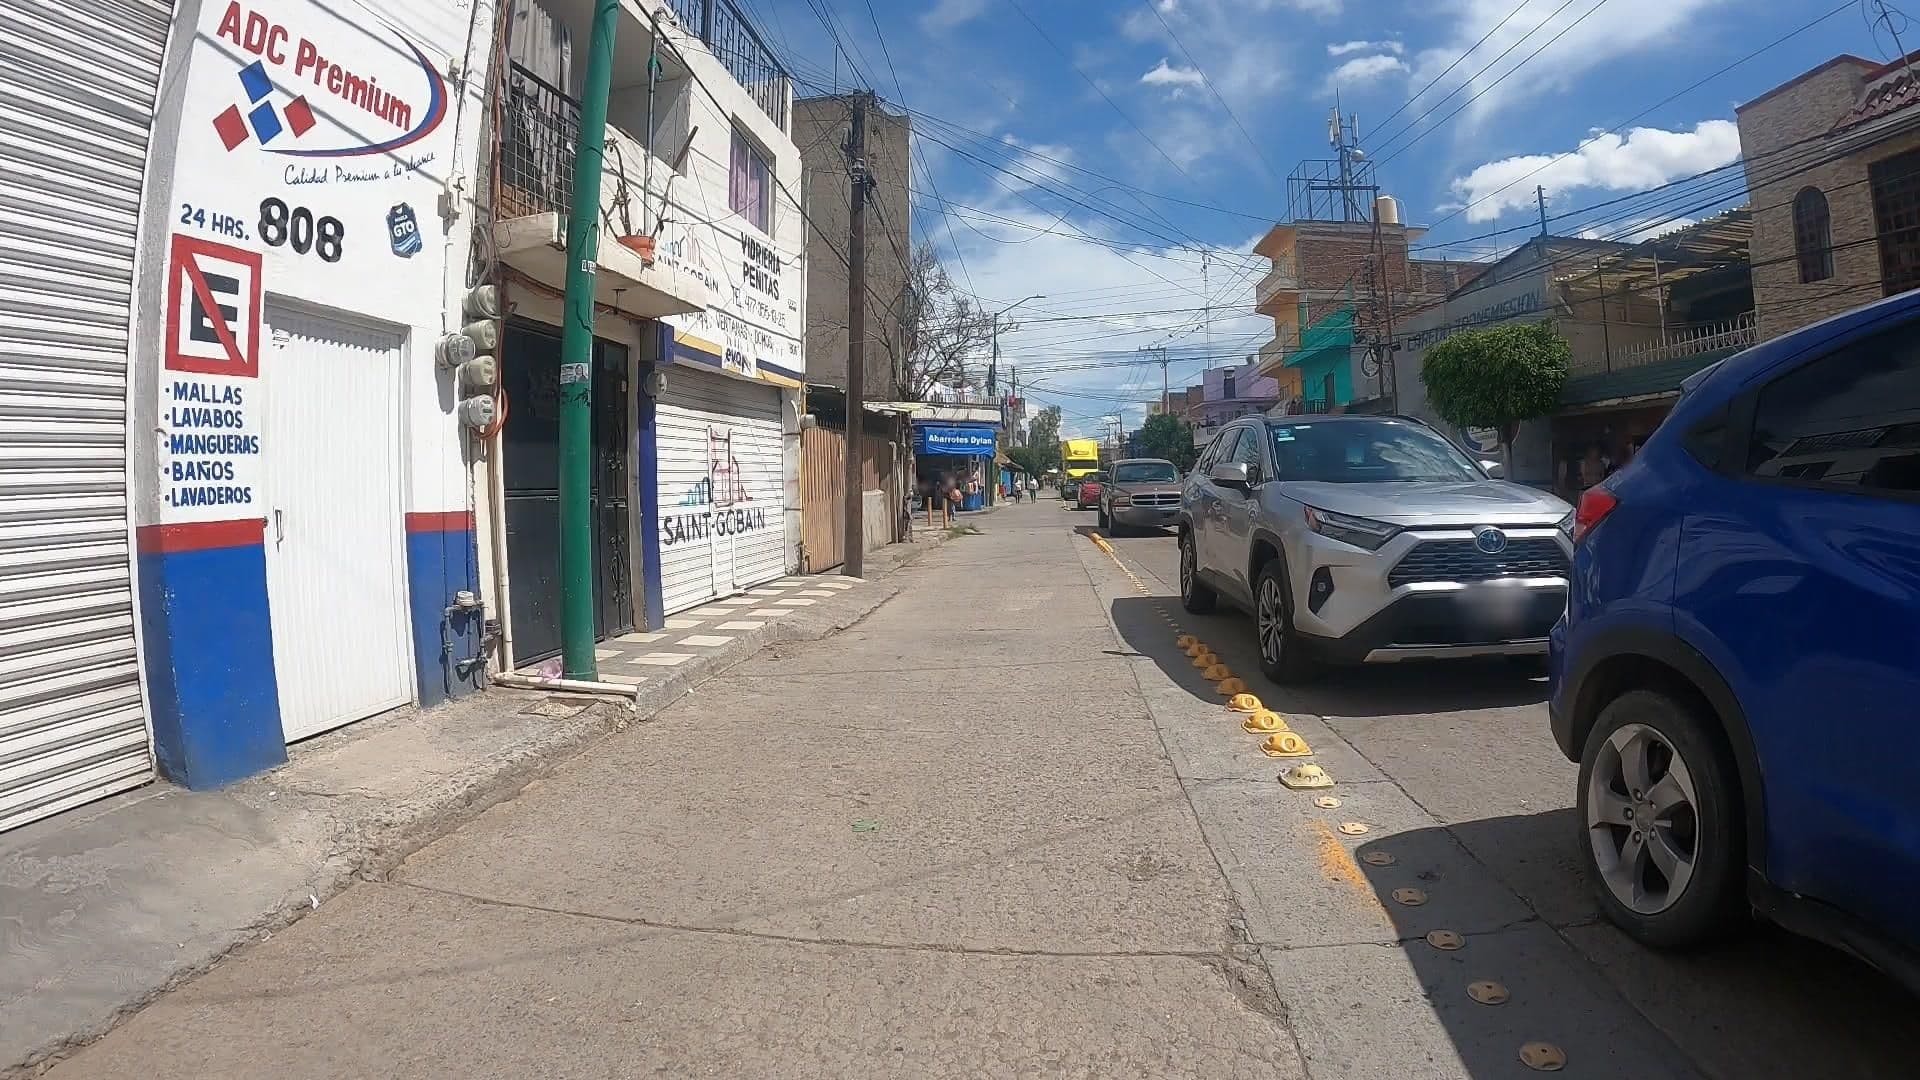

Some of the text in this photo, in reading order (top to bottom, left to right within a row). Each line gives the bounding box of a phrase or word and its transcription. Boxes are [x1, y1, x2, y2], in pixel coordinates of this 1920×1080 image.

[217, 0, 413, 132] ADC Premium
[284, 164, 328, 185] Calidad
[336, 165, 380, 182] Premium
[179, 203, 250, 240] 24 HRS.
[258, 197, 345, 263] 808
[393, 220, 415, 238] GTO
[741, 231, 781, 277] VIDRIERÍA
[172, 382, 243, 405] MALLAS
[171, 407, 244, 429] LAVABOS
[170, 433, 260, 456] MANGUERAS
[928, 434, 969, 444] Abarrotes
[970, 436, 992, 446] Dylan
[172, 460, 235, 482] BAÑOS
[171, 486, 252, 507] LAVADEROS
